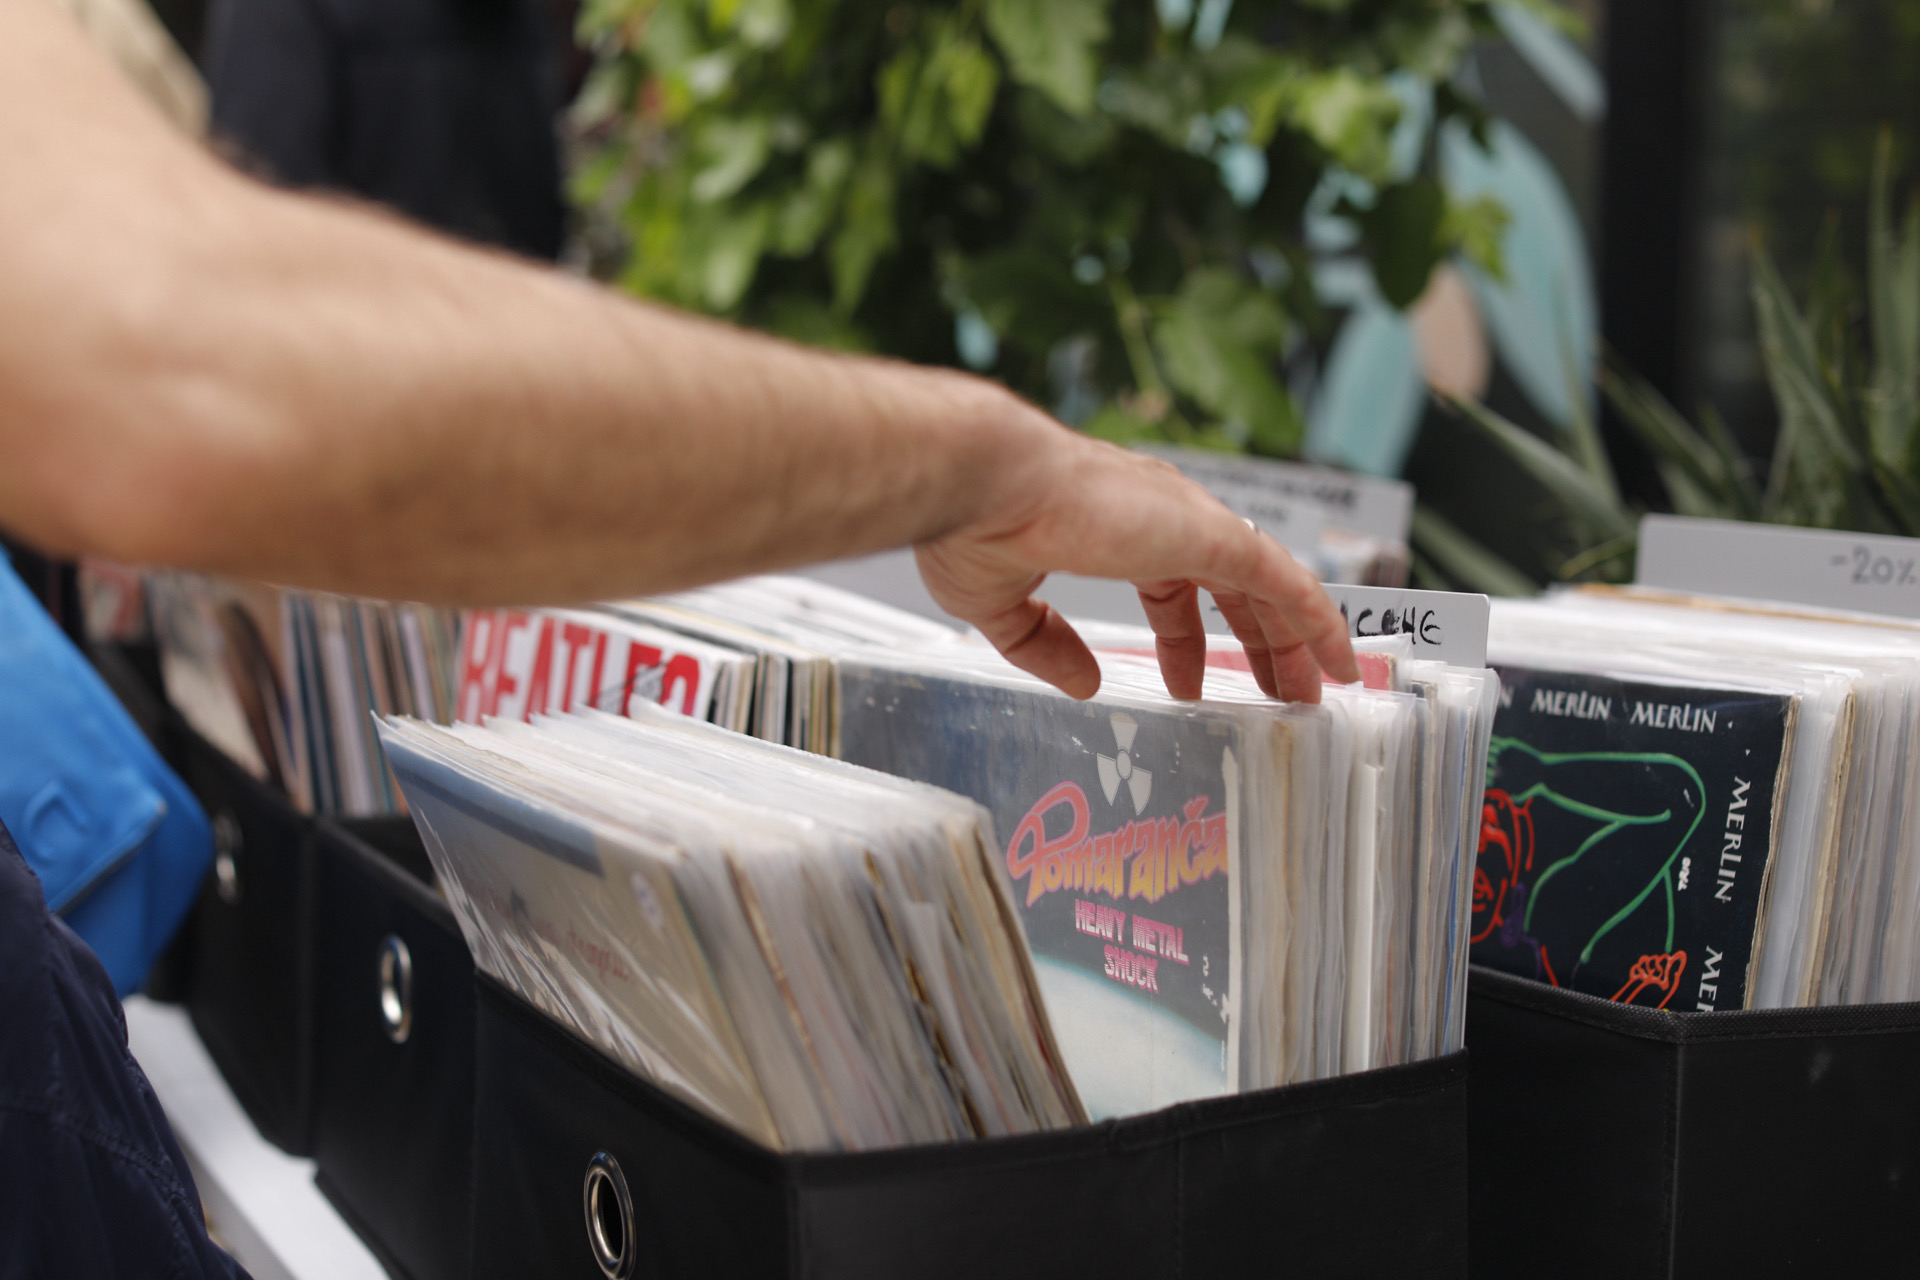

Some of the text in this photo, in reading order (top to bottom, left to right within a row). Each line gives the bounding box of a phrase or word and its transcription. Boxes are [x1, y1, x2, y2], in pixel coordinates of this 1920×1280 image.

[1531, 689, 1612, 720] MERLIN
[1630, 702, 1717, 733] MERLIN
[1714, 777, 1751, 902] MERLIN
[1075, 900, 1190, 964] HEAVY METAL
[1104, 945, 1159, 993] SHOCK
